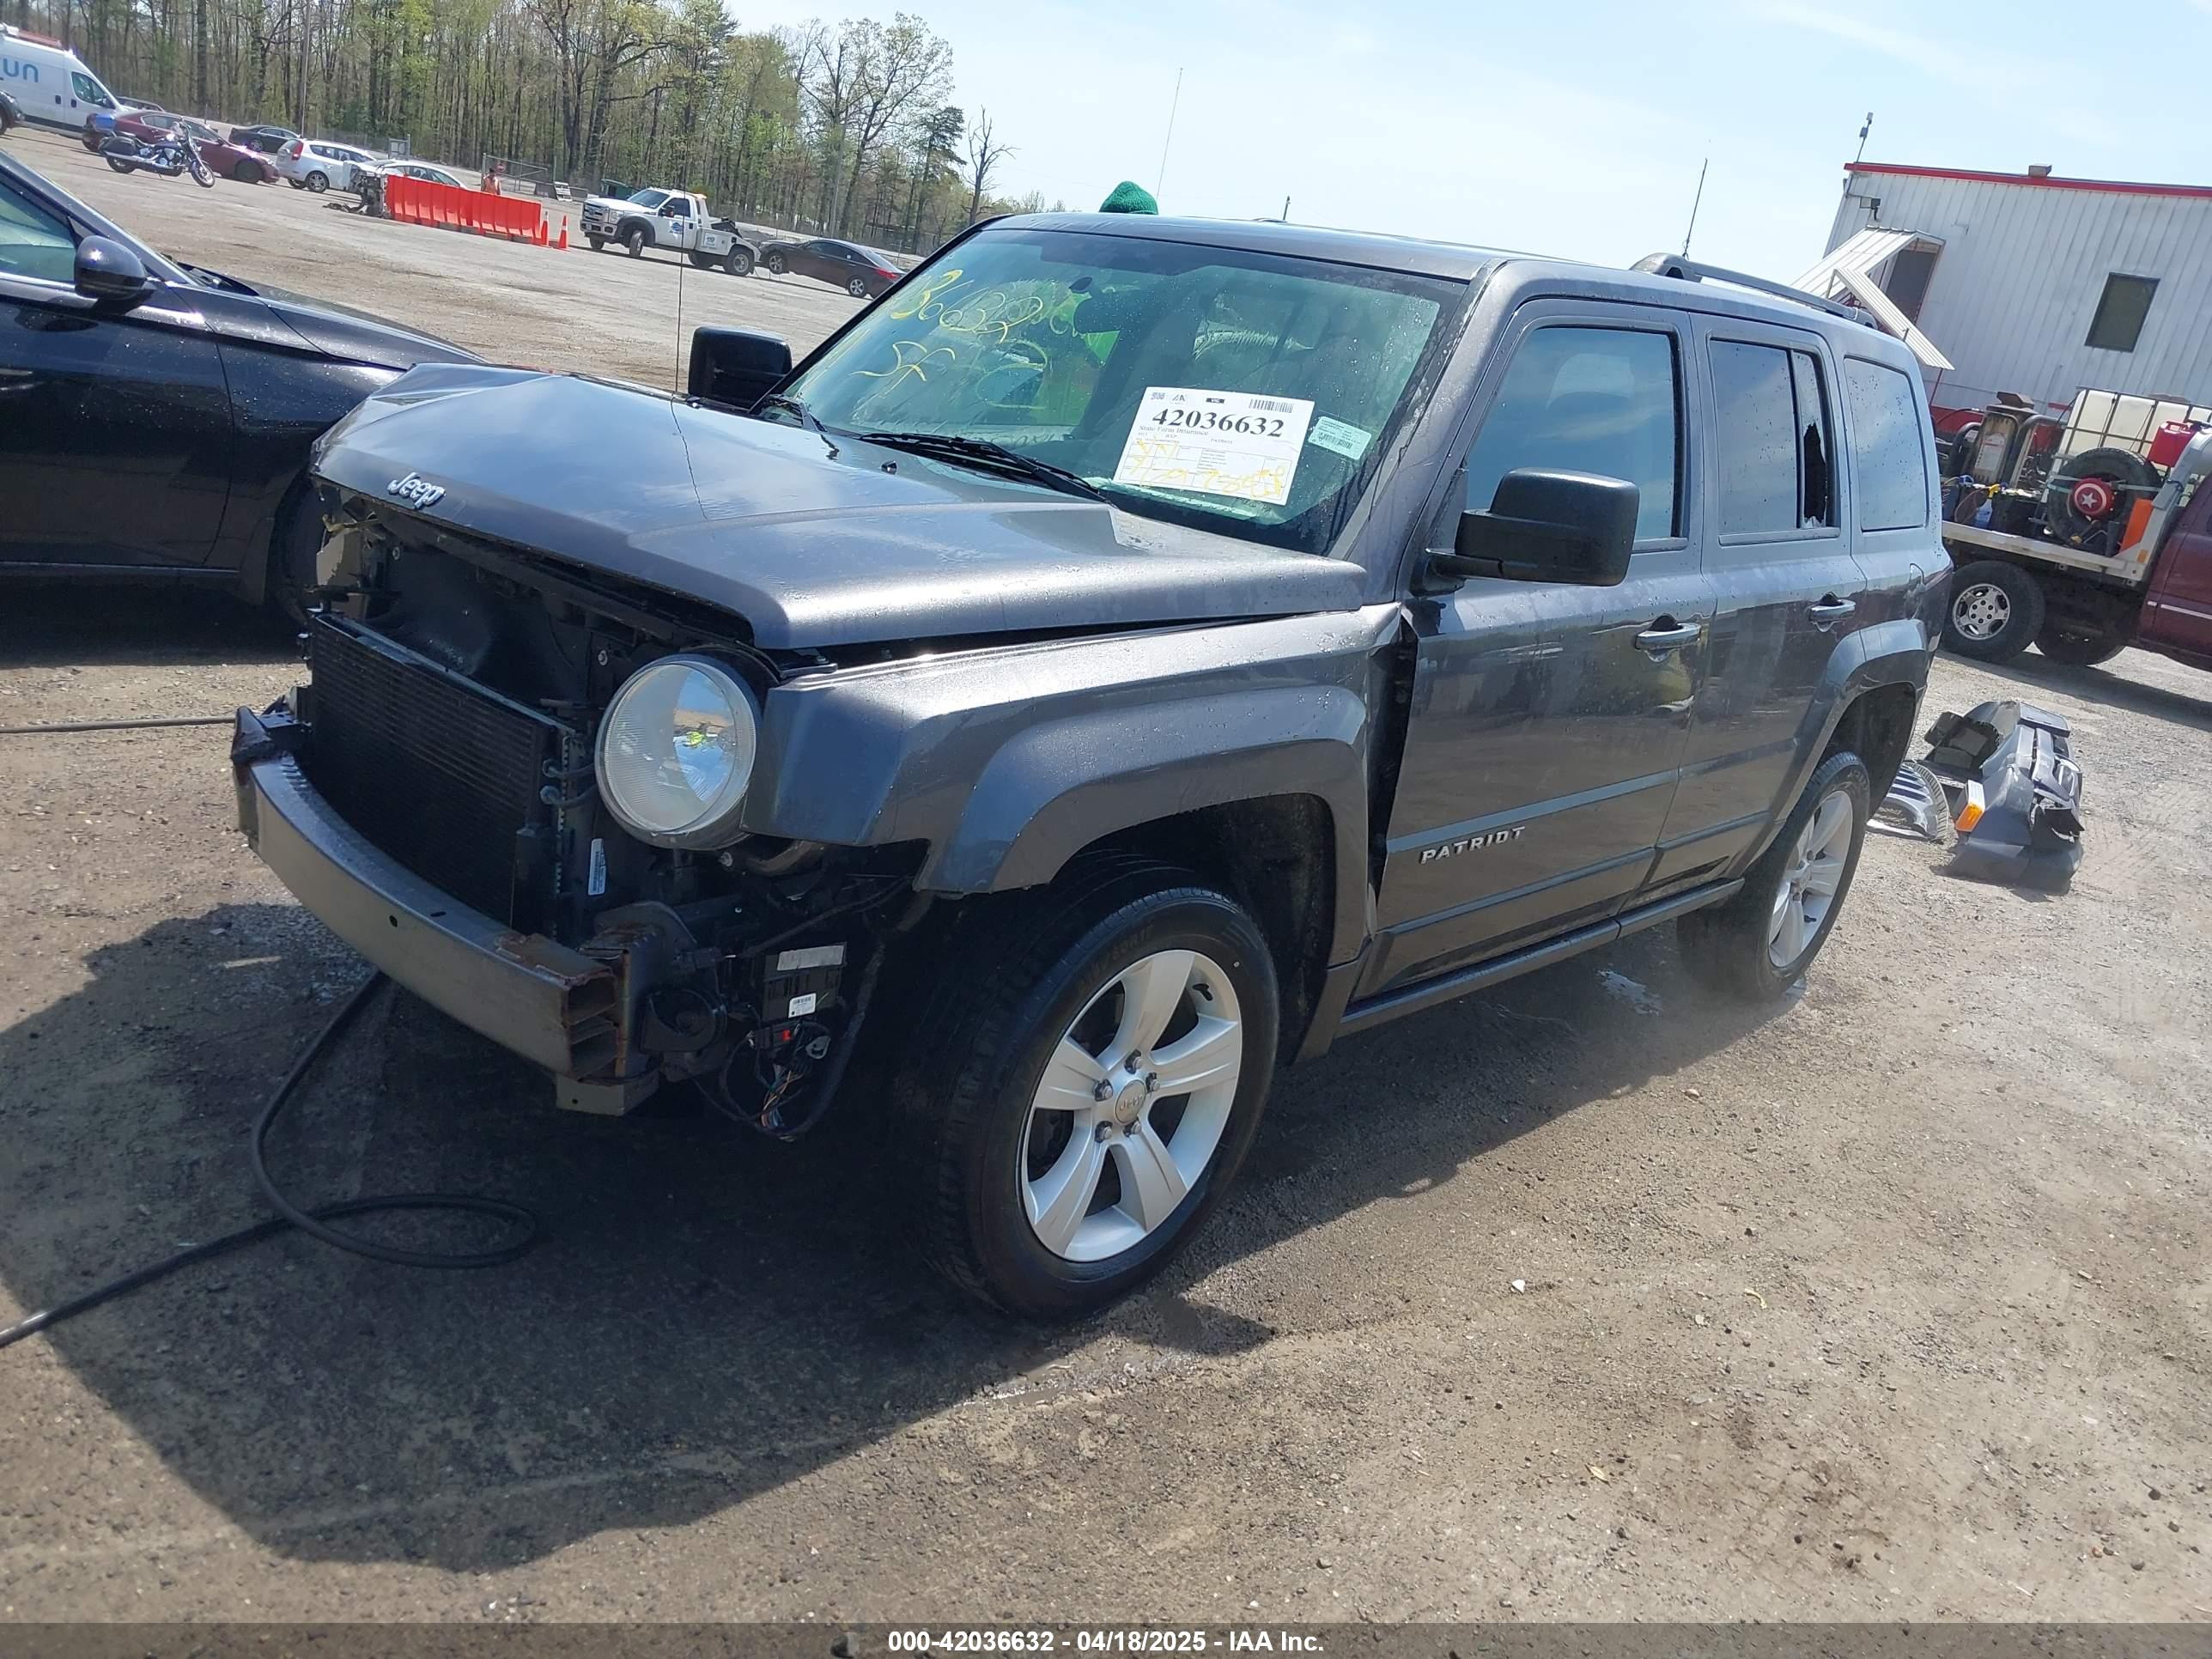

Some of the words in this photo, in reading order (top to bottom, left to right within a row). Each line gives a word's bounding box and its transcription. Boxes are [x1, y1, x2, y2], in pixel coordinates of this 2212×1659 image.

[1152, 408, 1284, 438] 42036632
[386, 471, 447, 509] Jeep
[1419, 826, 1526, 865] PATRIOT
